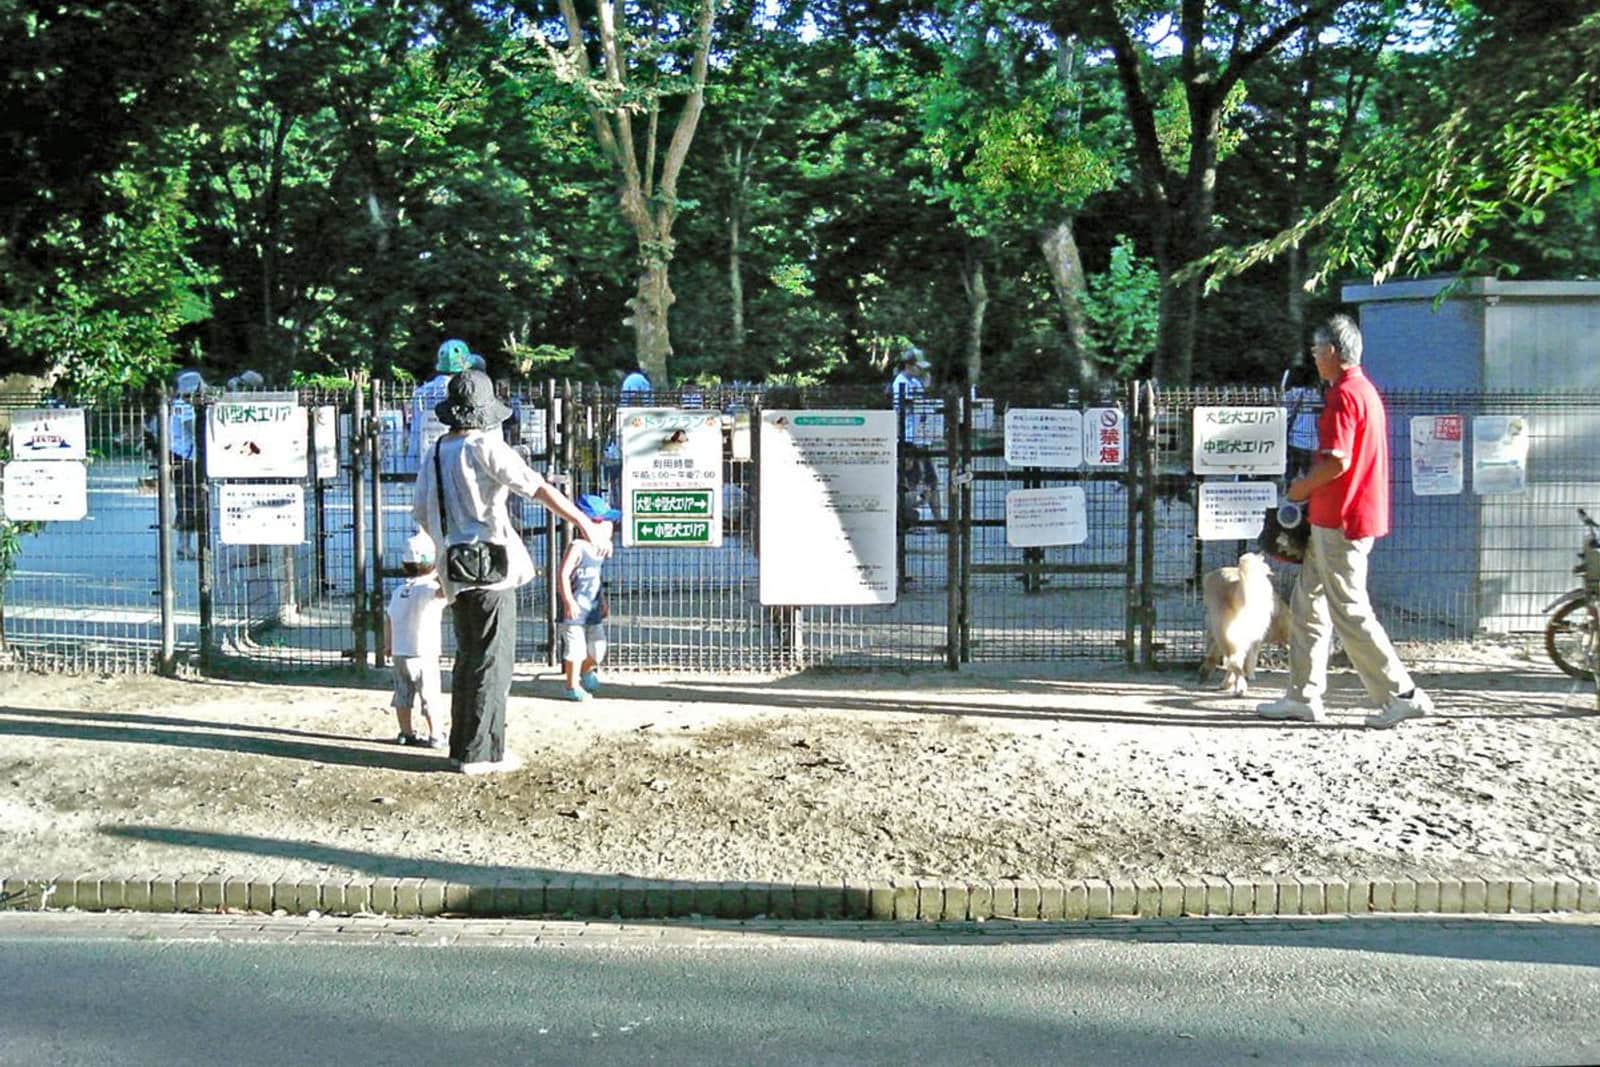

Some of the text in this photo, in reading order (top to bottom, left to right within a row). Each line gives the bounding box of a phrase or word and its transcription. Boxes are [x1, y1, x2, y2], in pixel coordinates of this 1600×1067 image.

[1205, 410, 1276, 425] 大型犬エリア
[1099, 428, 1121, 463] 禁煙
[1203, 439, 1276, 454] 中型犬エリア
[654, 522, 706, 538] 小型犬エリア
